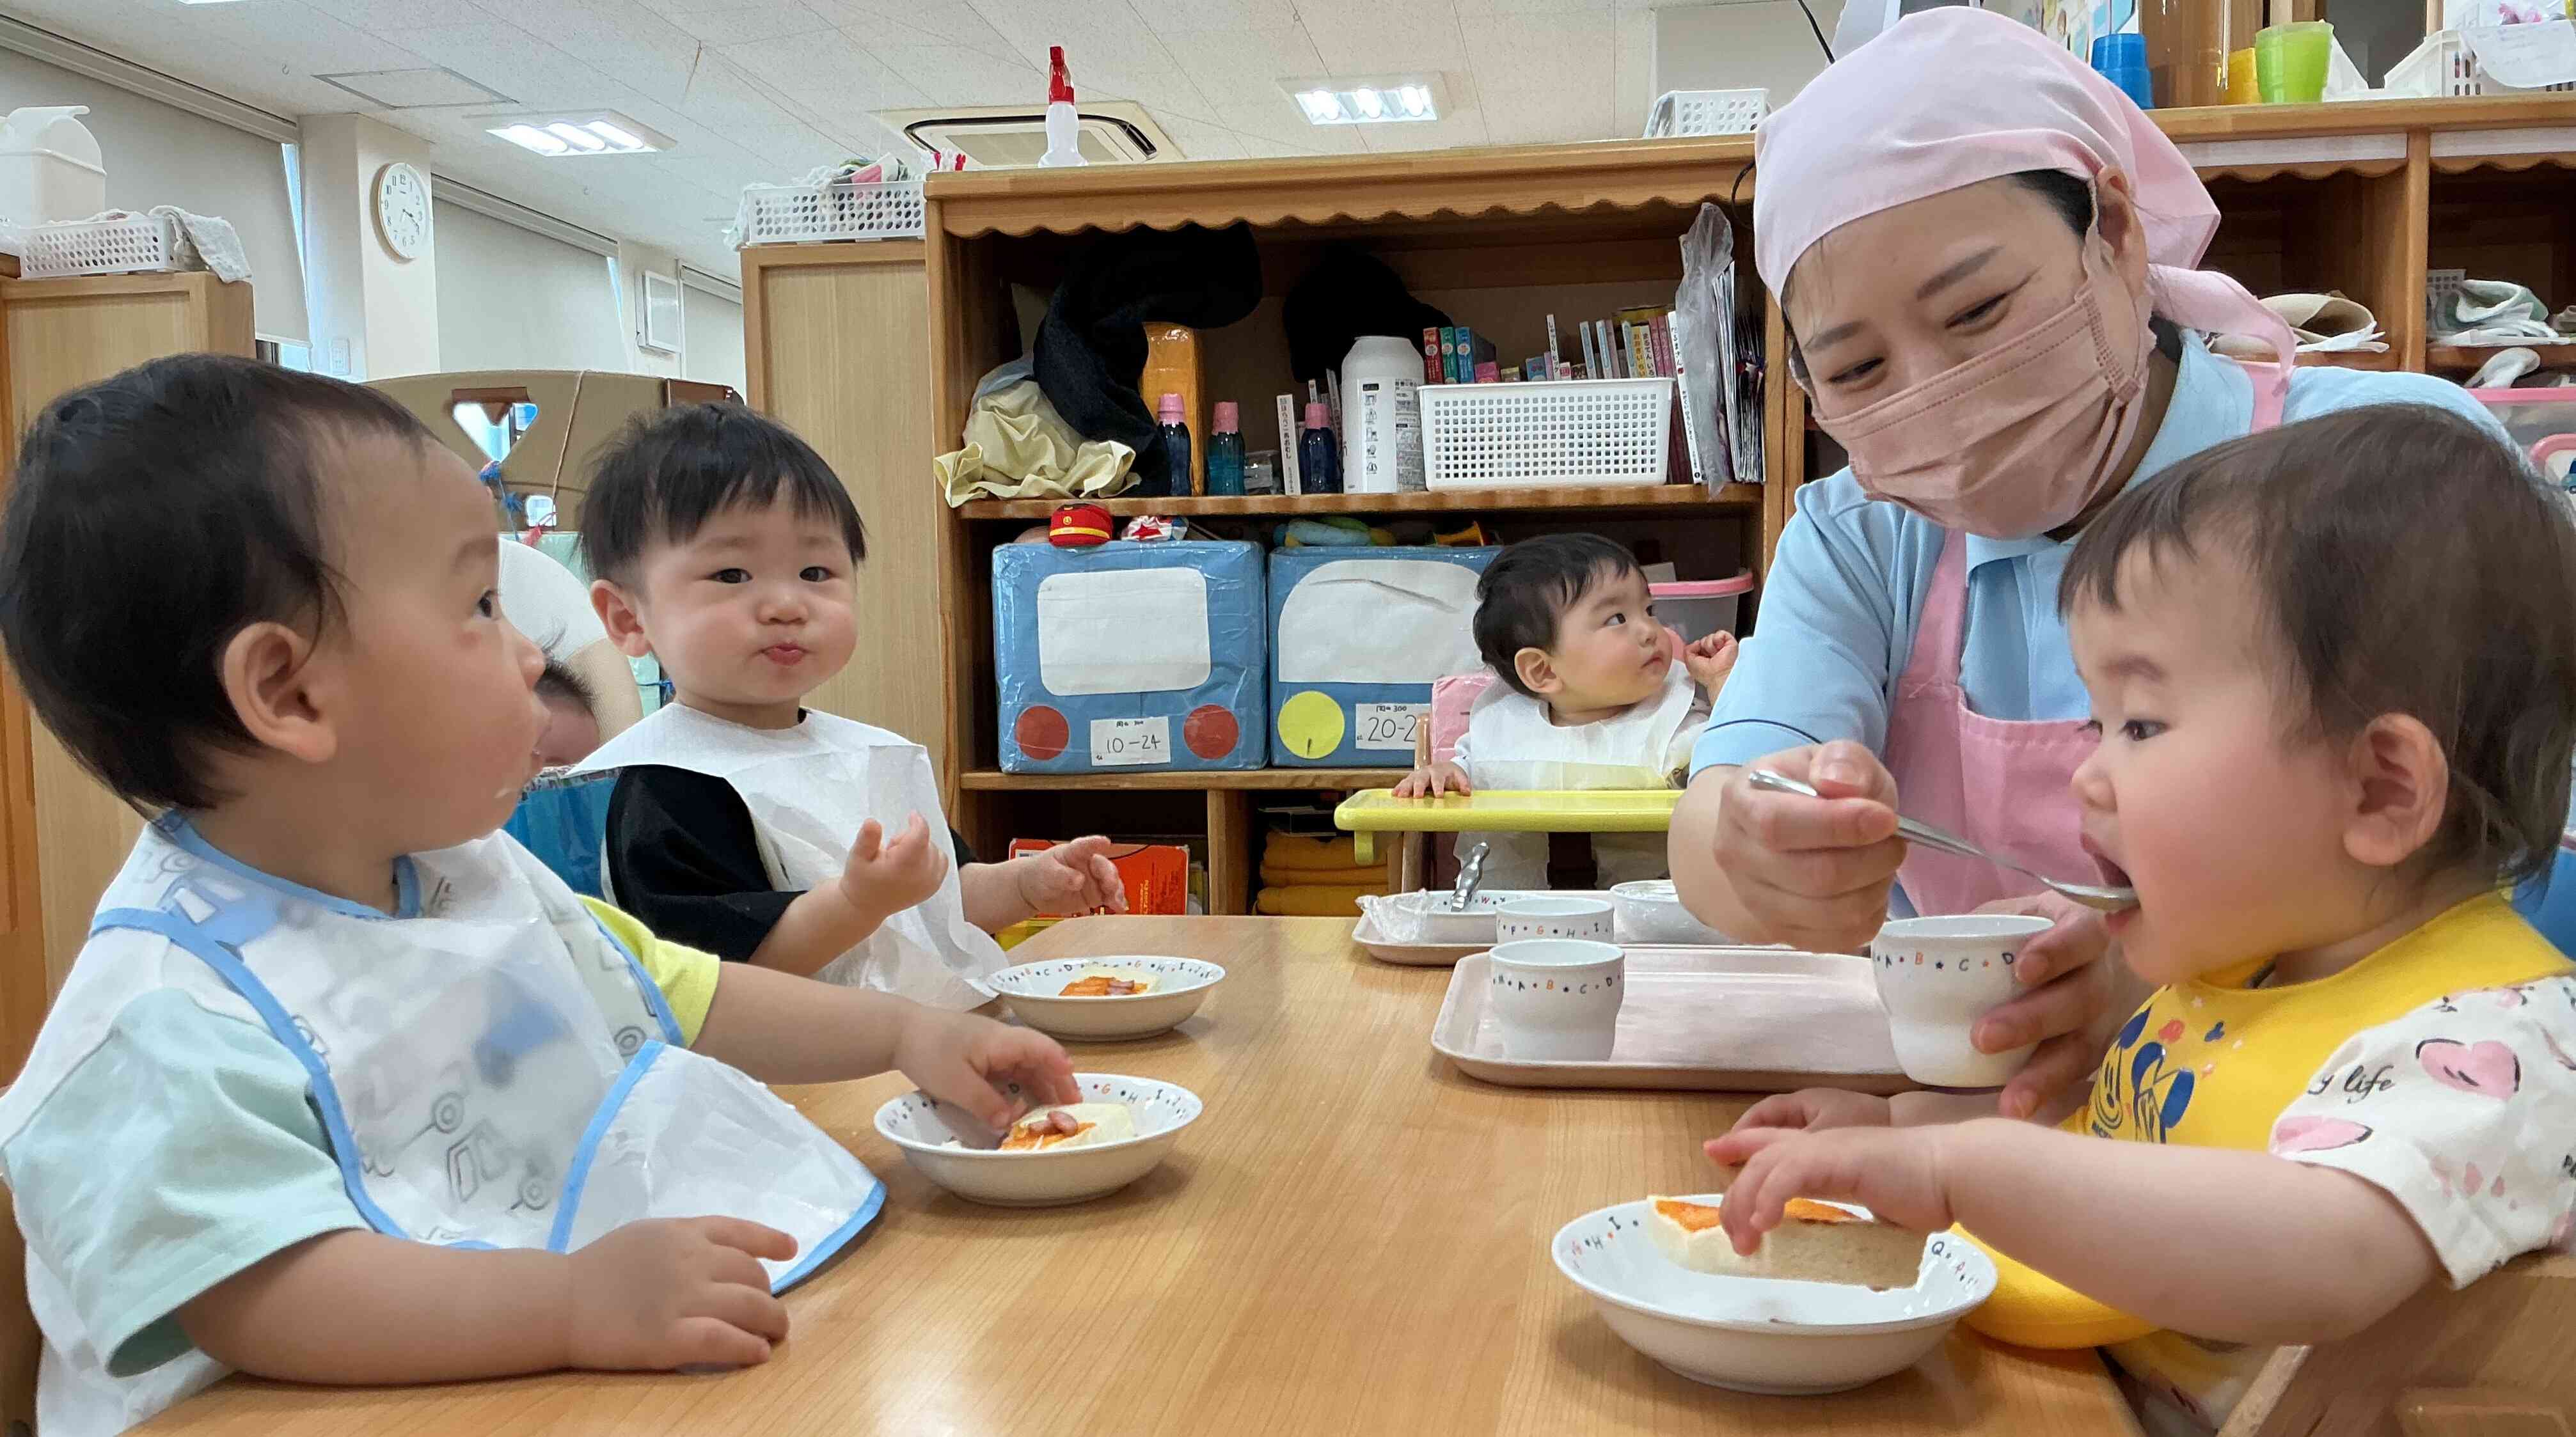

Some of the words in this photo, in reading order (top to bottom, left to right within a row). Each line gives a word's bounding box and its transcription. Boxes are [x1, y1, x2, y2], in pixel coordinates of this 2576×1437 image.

[1537, 926, 1544, 935] G
[1567, 929, 1575, 938] H
[1134, 960, 1141, 968] G
[1959, 959, 1970, 971] C
[2002, 952, 2014, 964] D
[1519, 981, 1525, 991] A
[1546, 979, 1554, 990] B
[1580, 984, 1587, 994] C
[1606, 977, 1612, 987] D
[1102, 1083, 1111, 1094] G
[1127, 1092, 1139, 1104] H
[1155, 1089, 1163, 1100] I
[2343, 1064, 2396, 1104] life
[1591, 1235, 1604, 1251] H
[1608, 1216, 1622, 1230] I
[1932, 1241, 1945, 1257] Q
